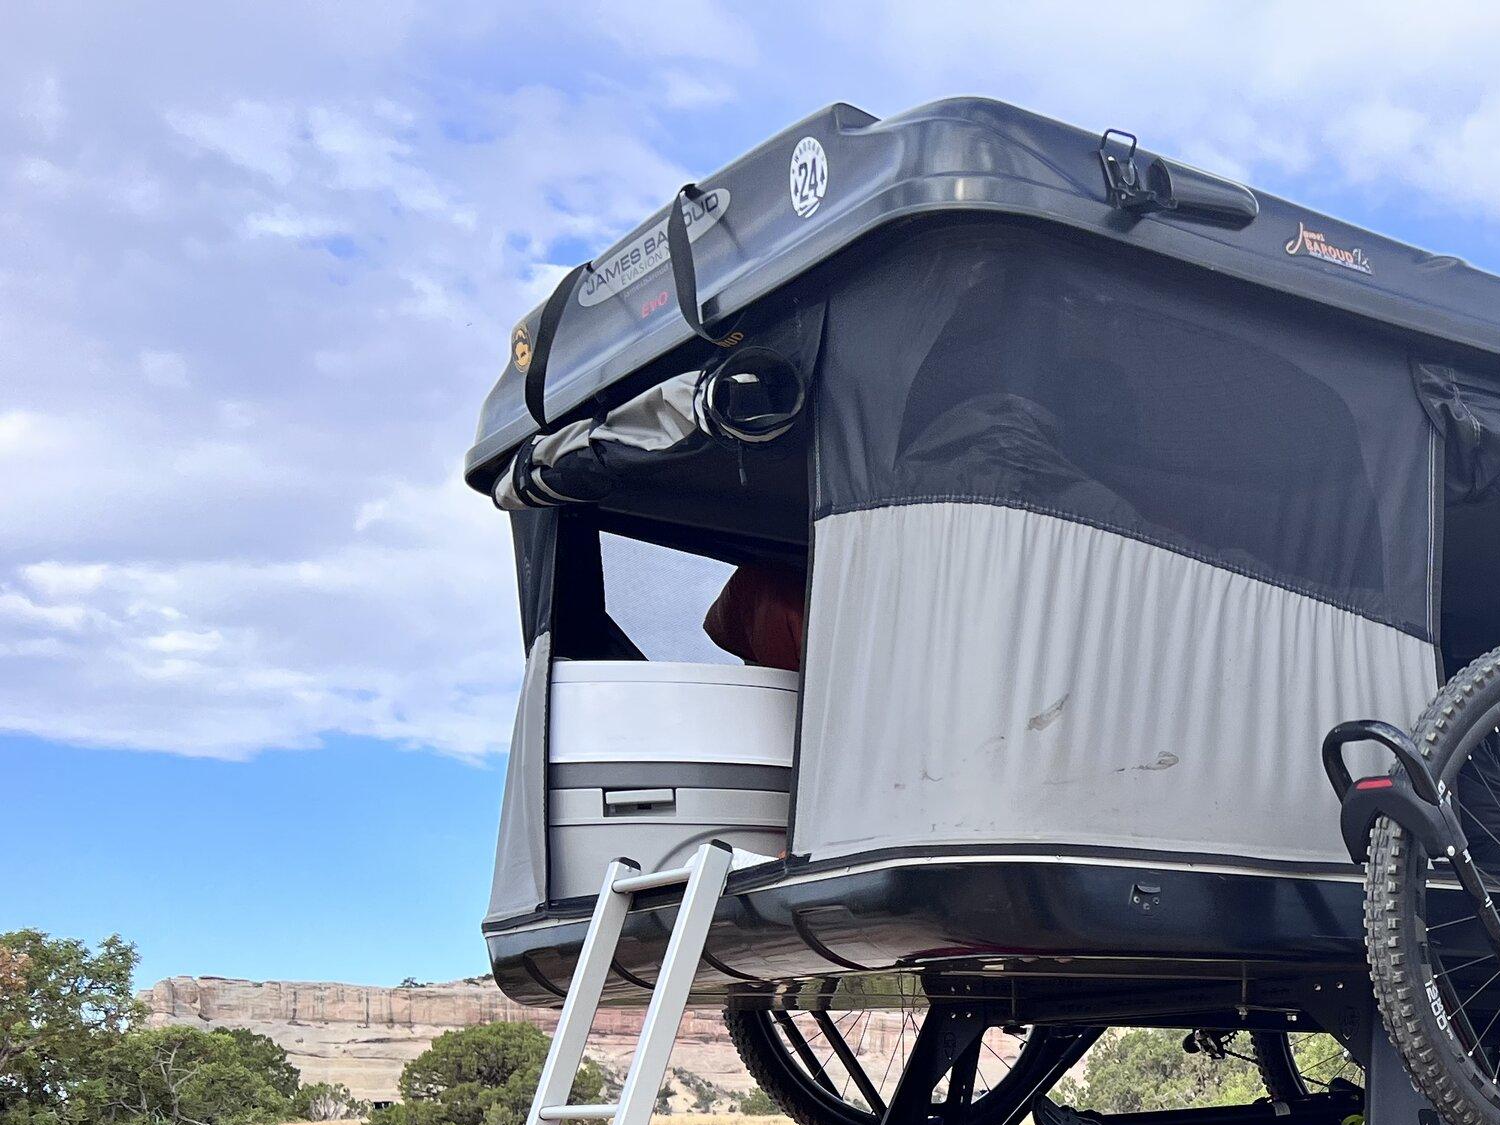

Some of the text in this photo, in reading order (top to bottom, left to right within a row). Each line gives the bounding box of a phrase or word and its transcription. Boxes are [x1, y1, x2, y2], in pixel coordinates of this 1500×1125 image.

[798, 157, 818, 202] 24
[586, 248, 641, 296] JAMES
[643, 192, 719, 256] BAOUD
[620, 253, 663, 285] EVASION
